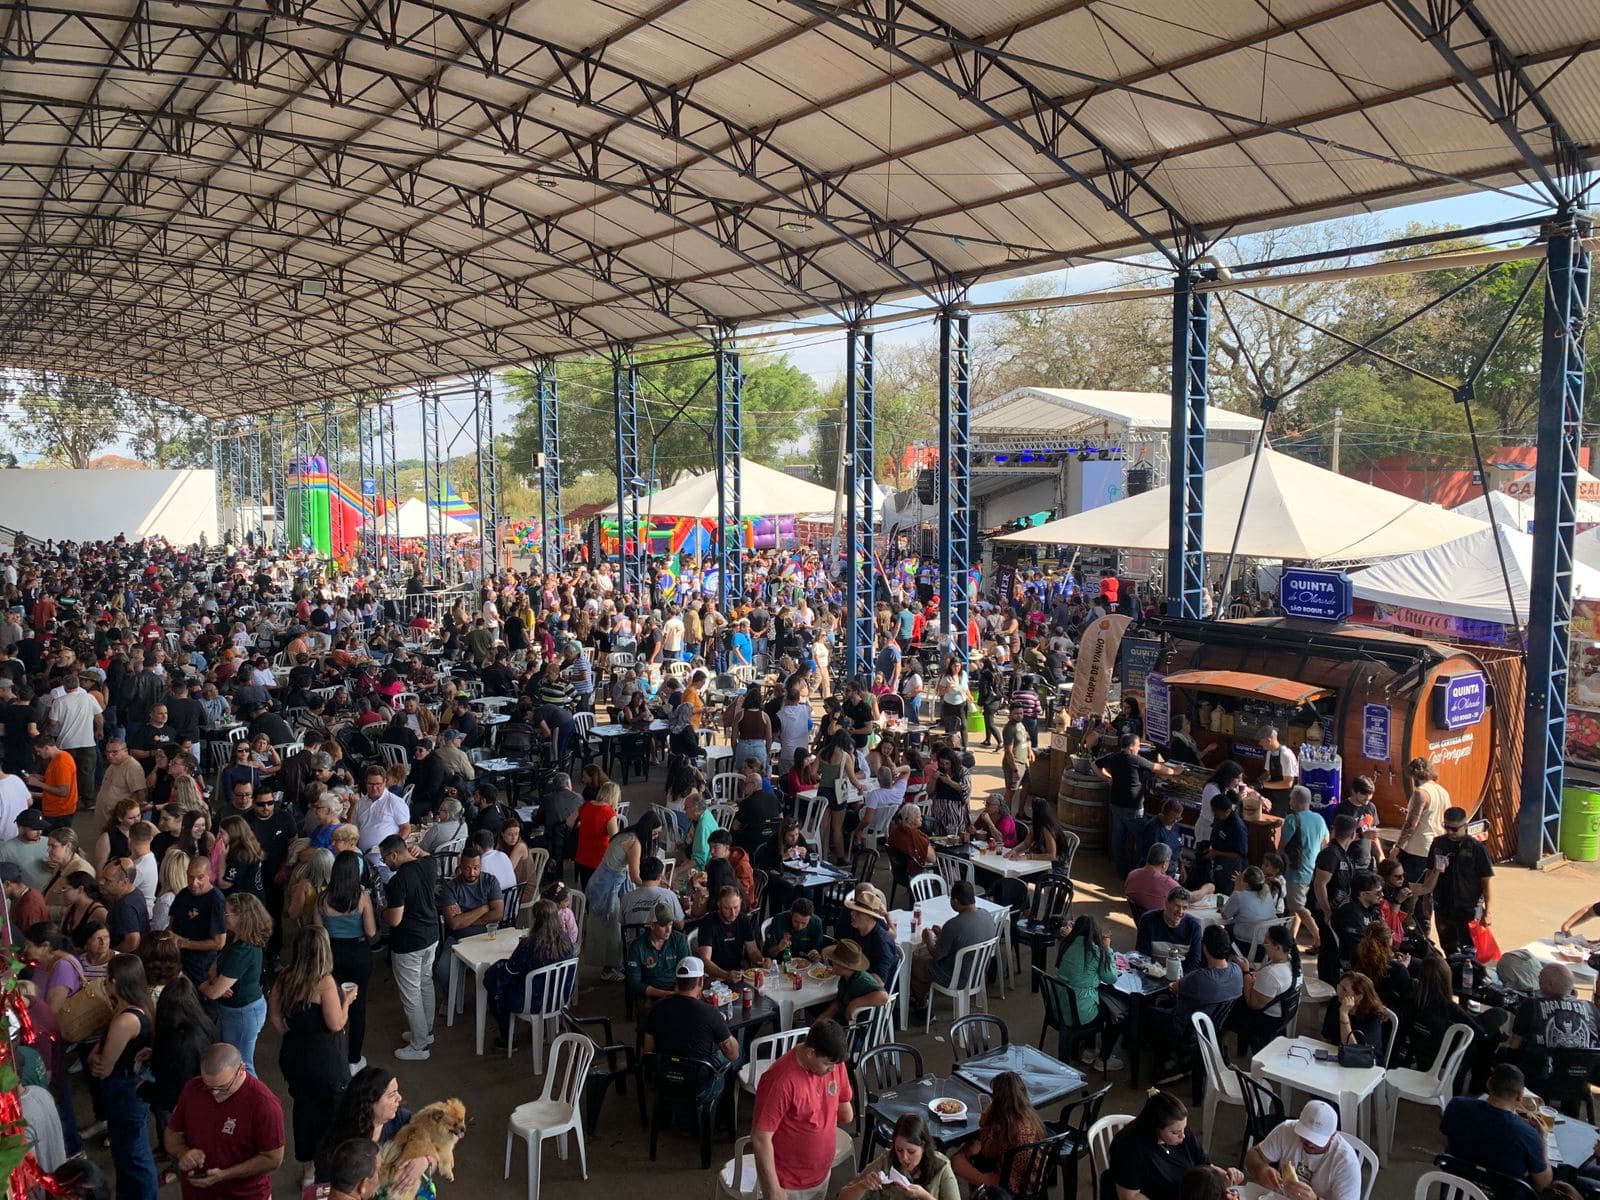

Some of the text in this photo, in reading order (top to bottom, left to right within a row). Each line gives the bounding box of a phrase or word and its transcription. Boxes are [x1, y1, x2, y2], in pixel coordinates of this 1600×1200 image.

[1290, 580, 1334, 592] QUINTA
[1085, 638, 1105, 704] CHOPP DE VINHO
[1452, 684, 1480, 698] QUINTA
